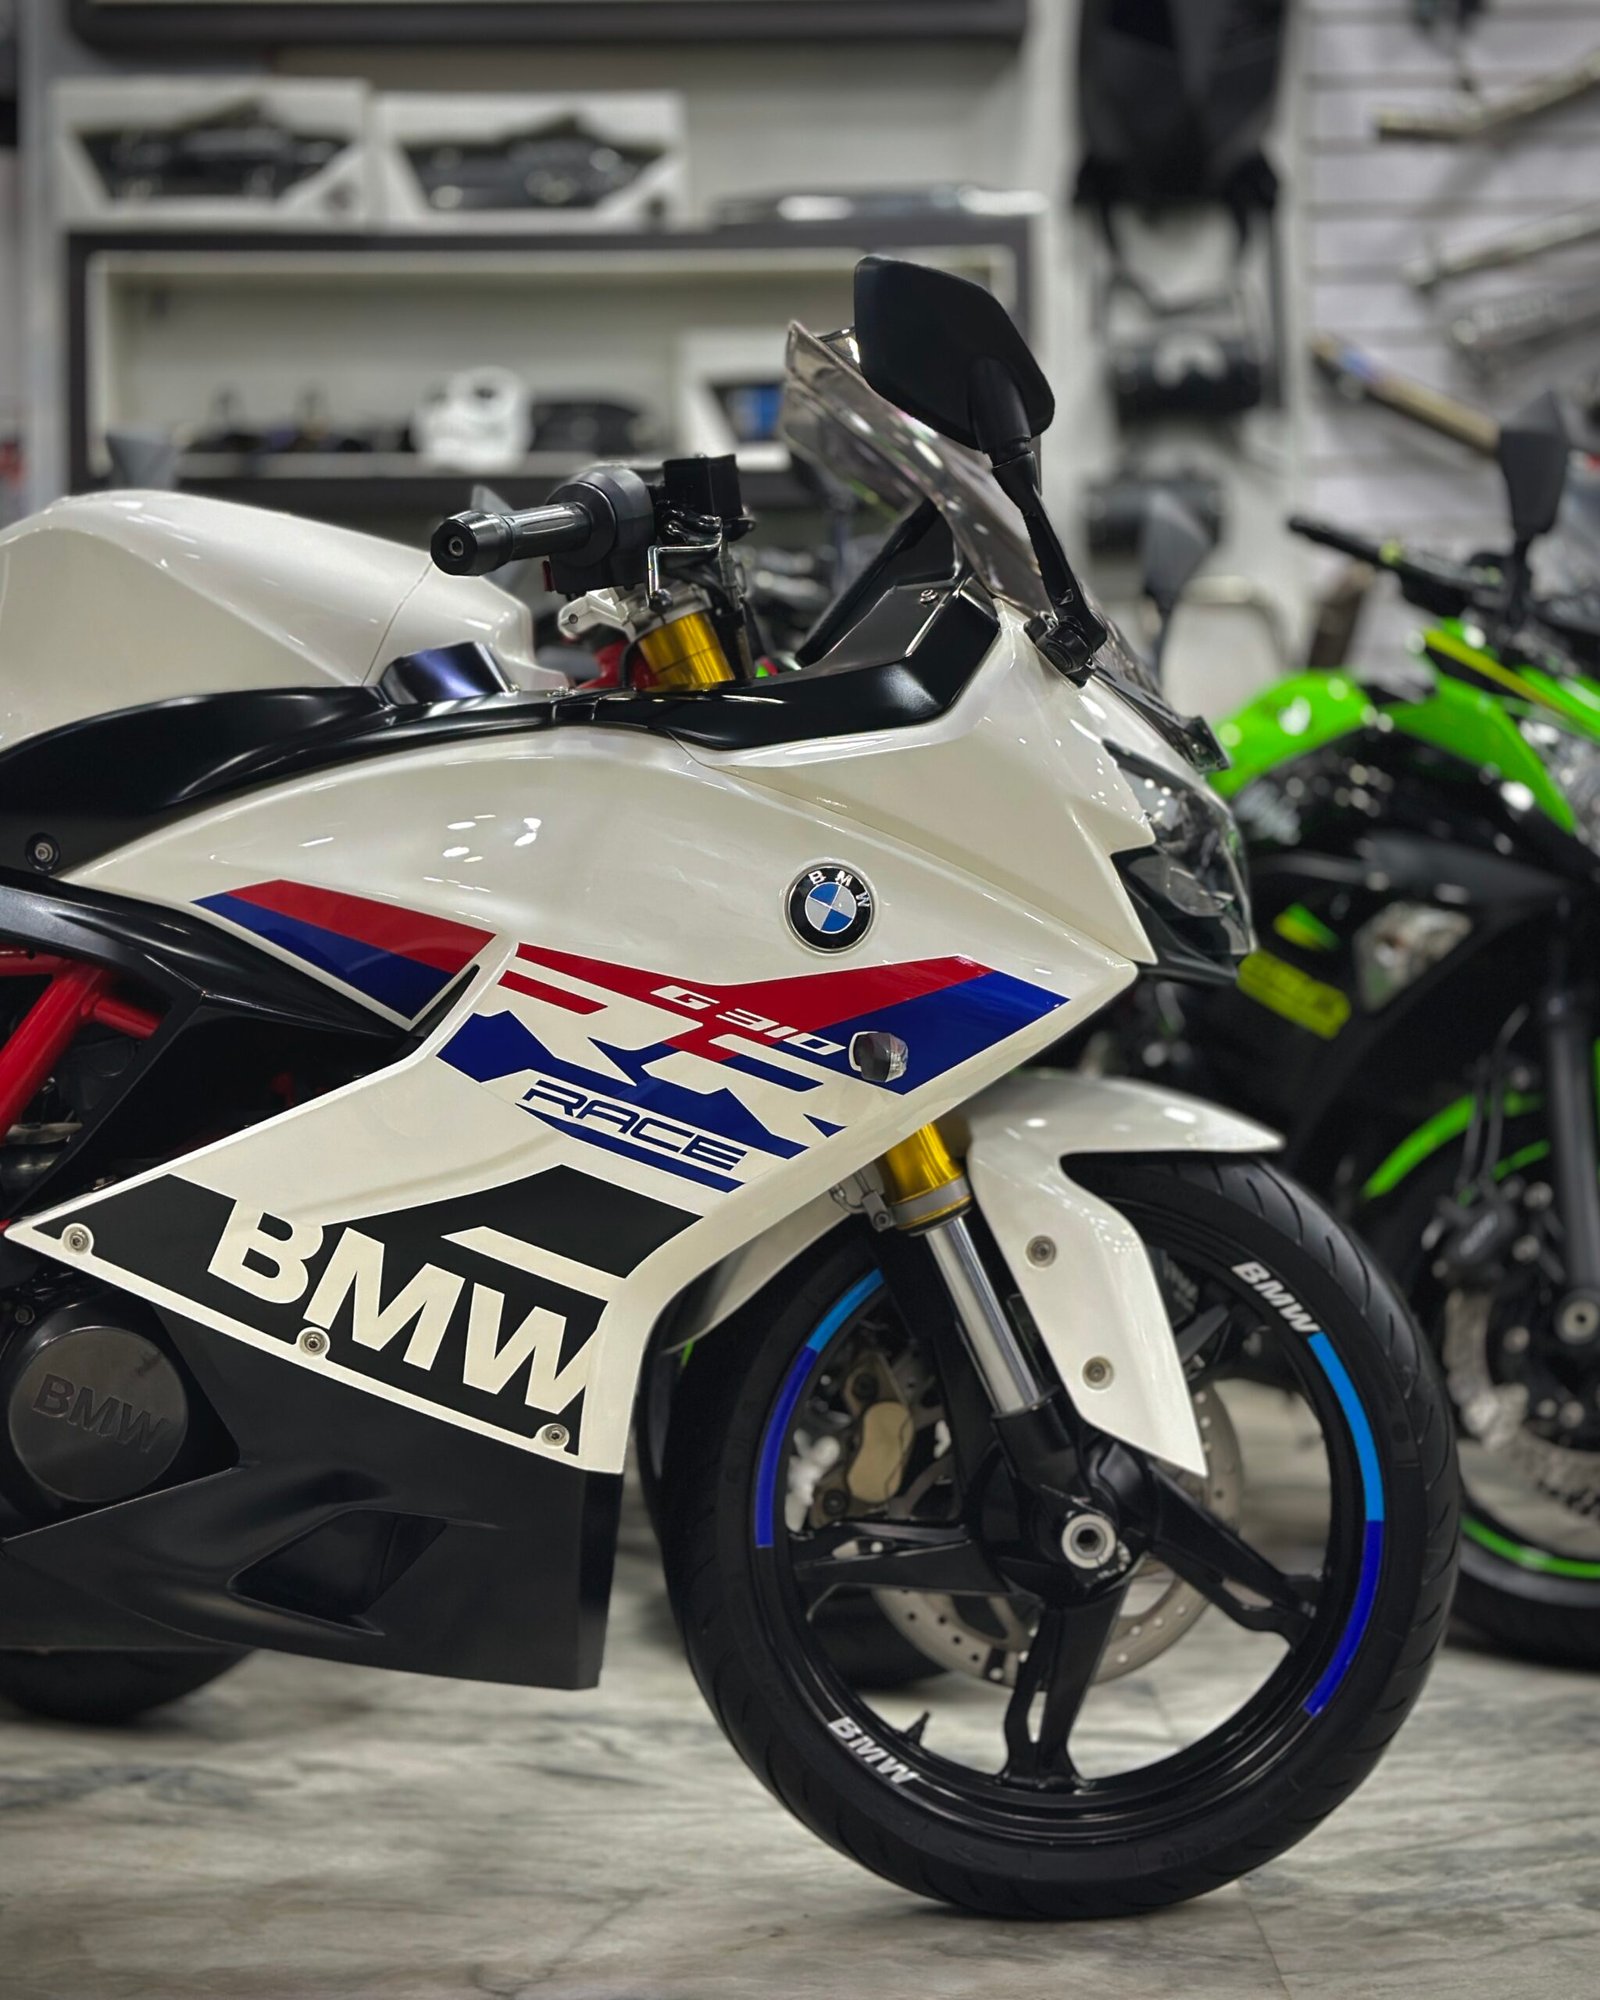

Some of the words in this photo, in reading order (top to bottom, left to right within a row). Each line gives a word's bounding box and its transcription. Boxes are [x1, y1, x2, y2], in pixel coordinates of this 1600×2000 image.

[808, 870, 871, 908] BMW
[650, 985, 720, 1010] G
[716, 1008, 847, 1056] 310
[522, 1079, 748, 1172] RACE
[208, 1199, 606, 1415] BMW
[1231, 1261, 1321, 1332] BMW
[32, 1373, 169, 1453] BMW
[828, 1716, 919, 1784] BMW
